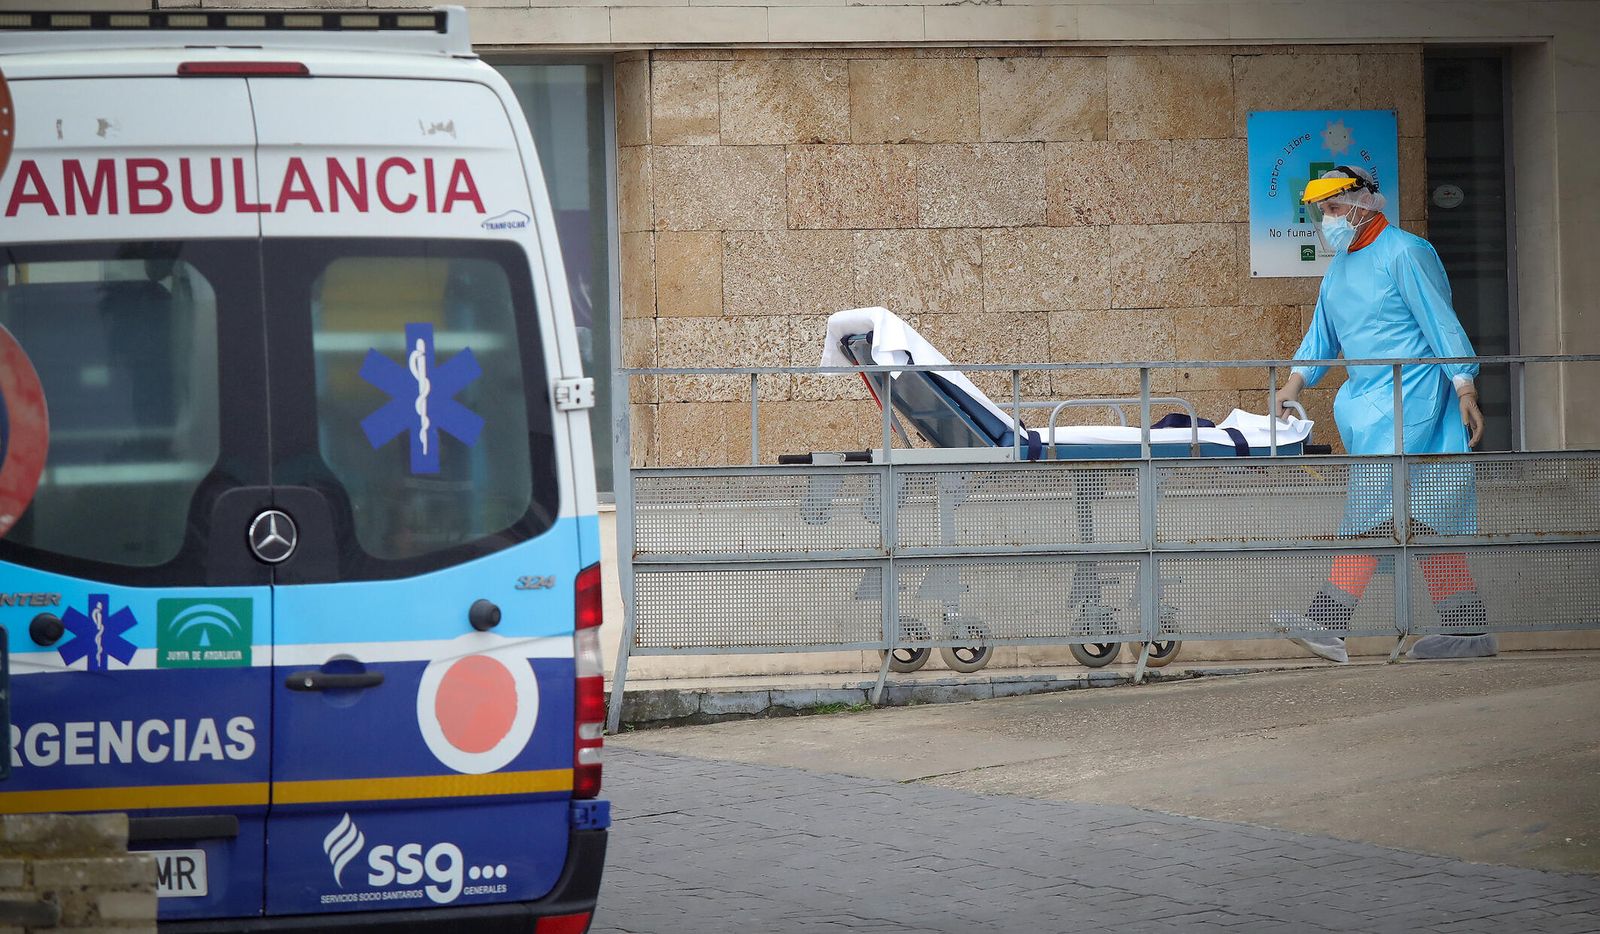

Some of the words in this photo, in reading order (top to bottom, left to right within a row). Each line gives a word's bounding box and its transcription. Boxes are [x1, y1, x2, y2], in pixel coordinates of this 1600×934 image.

[1269, 158, 1284, 197] Centro
[1283, 132, 1312, 155] libre
[1360, 148, 1371, 163] de
[4, 156, 486, 217] AMBULANCIA
[1269, 228, 1282, 238] No
[1287, 228, 1316, 238] fumar
[514, 575, 556, 590] 324
[320, 892, 358, 904] SERVICIOS
[359, 890, 382, 902] SOCIO
[382, 889, 424, 900] SANITARIOS
[463, 884, 507, 896] GENERALES
